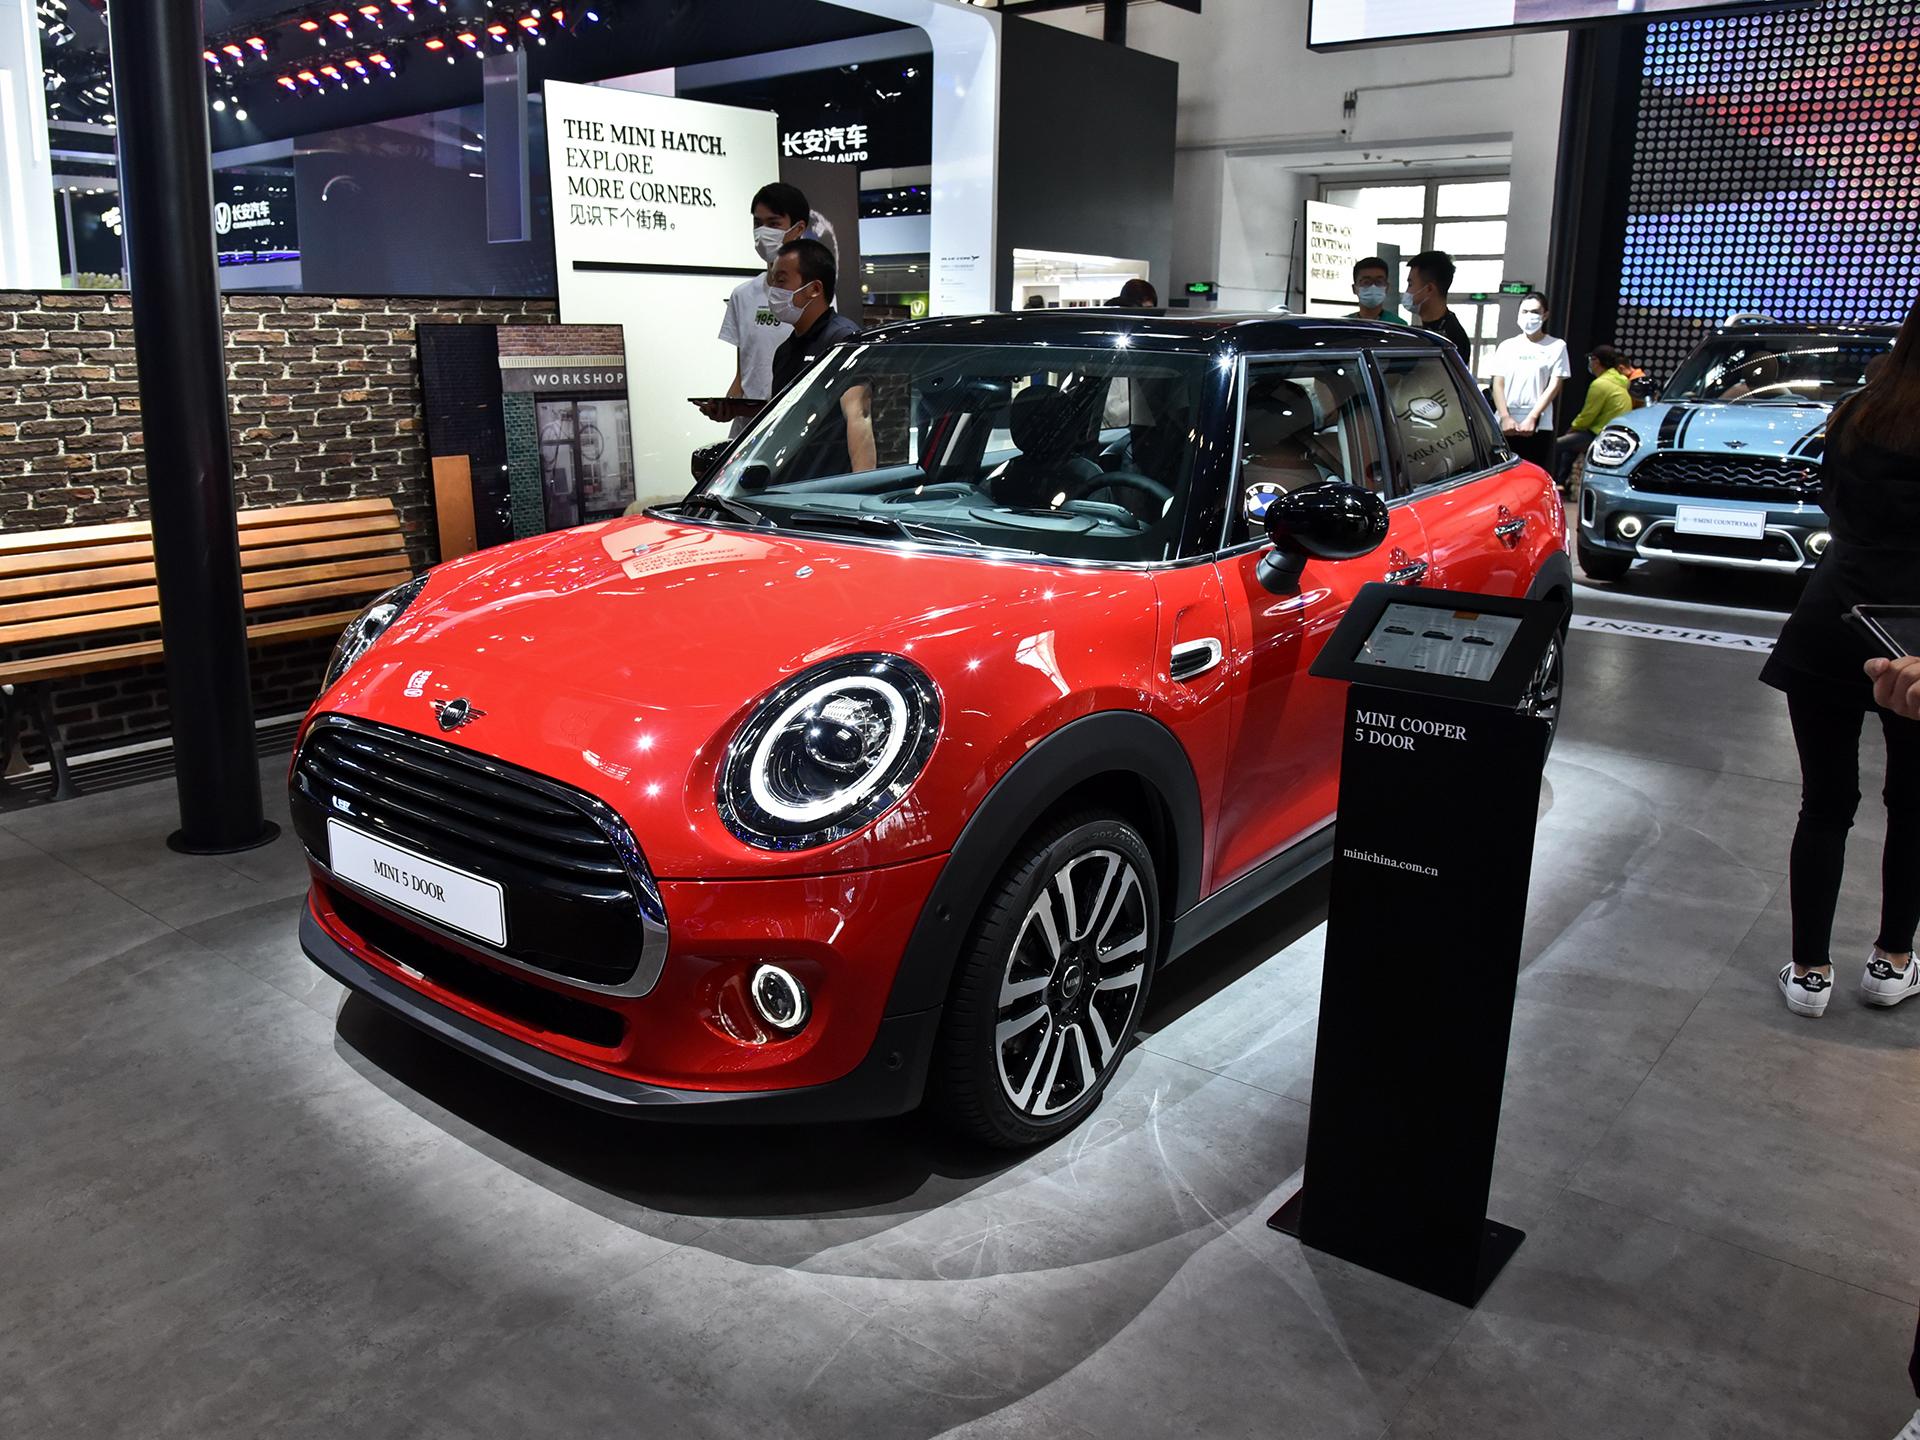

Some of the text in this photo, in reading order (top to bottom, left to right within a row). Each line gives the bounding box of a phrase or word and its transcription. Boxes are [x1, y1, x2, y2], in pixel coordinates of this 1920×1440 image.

[563, 118, 727, 156] THE MINI HATCH.
[782, 124, 868, 157] 长安汽车
[566, 147, 654, 175] EXPLORE
[837, 151, 868, 163] AUTO
[568, 176, 716, 208] MORE CORNERS.
[570, 204, 676, 231] 见识下个街角。
[533, 373, 624, 386] WORKSHOP
[1355, 709, 1467, 741] MINI COOPER
[1355, 728, 1415, 751] 5 DOOR
[1343, 848, 1439, 877] minichina.com.cn
[373, 858, 446, 902] MINI 5 DOOR
